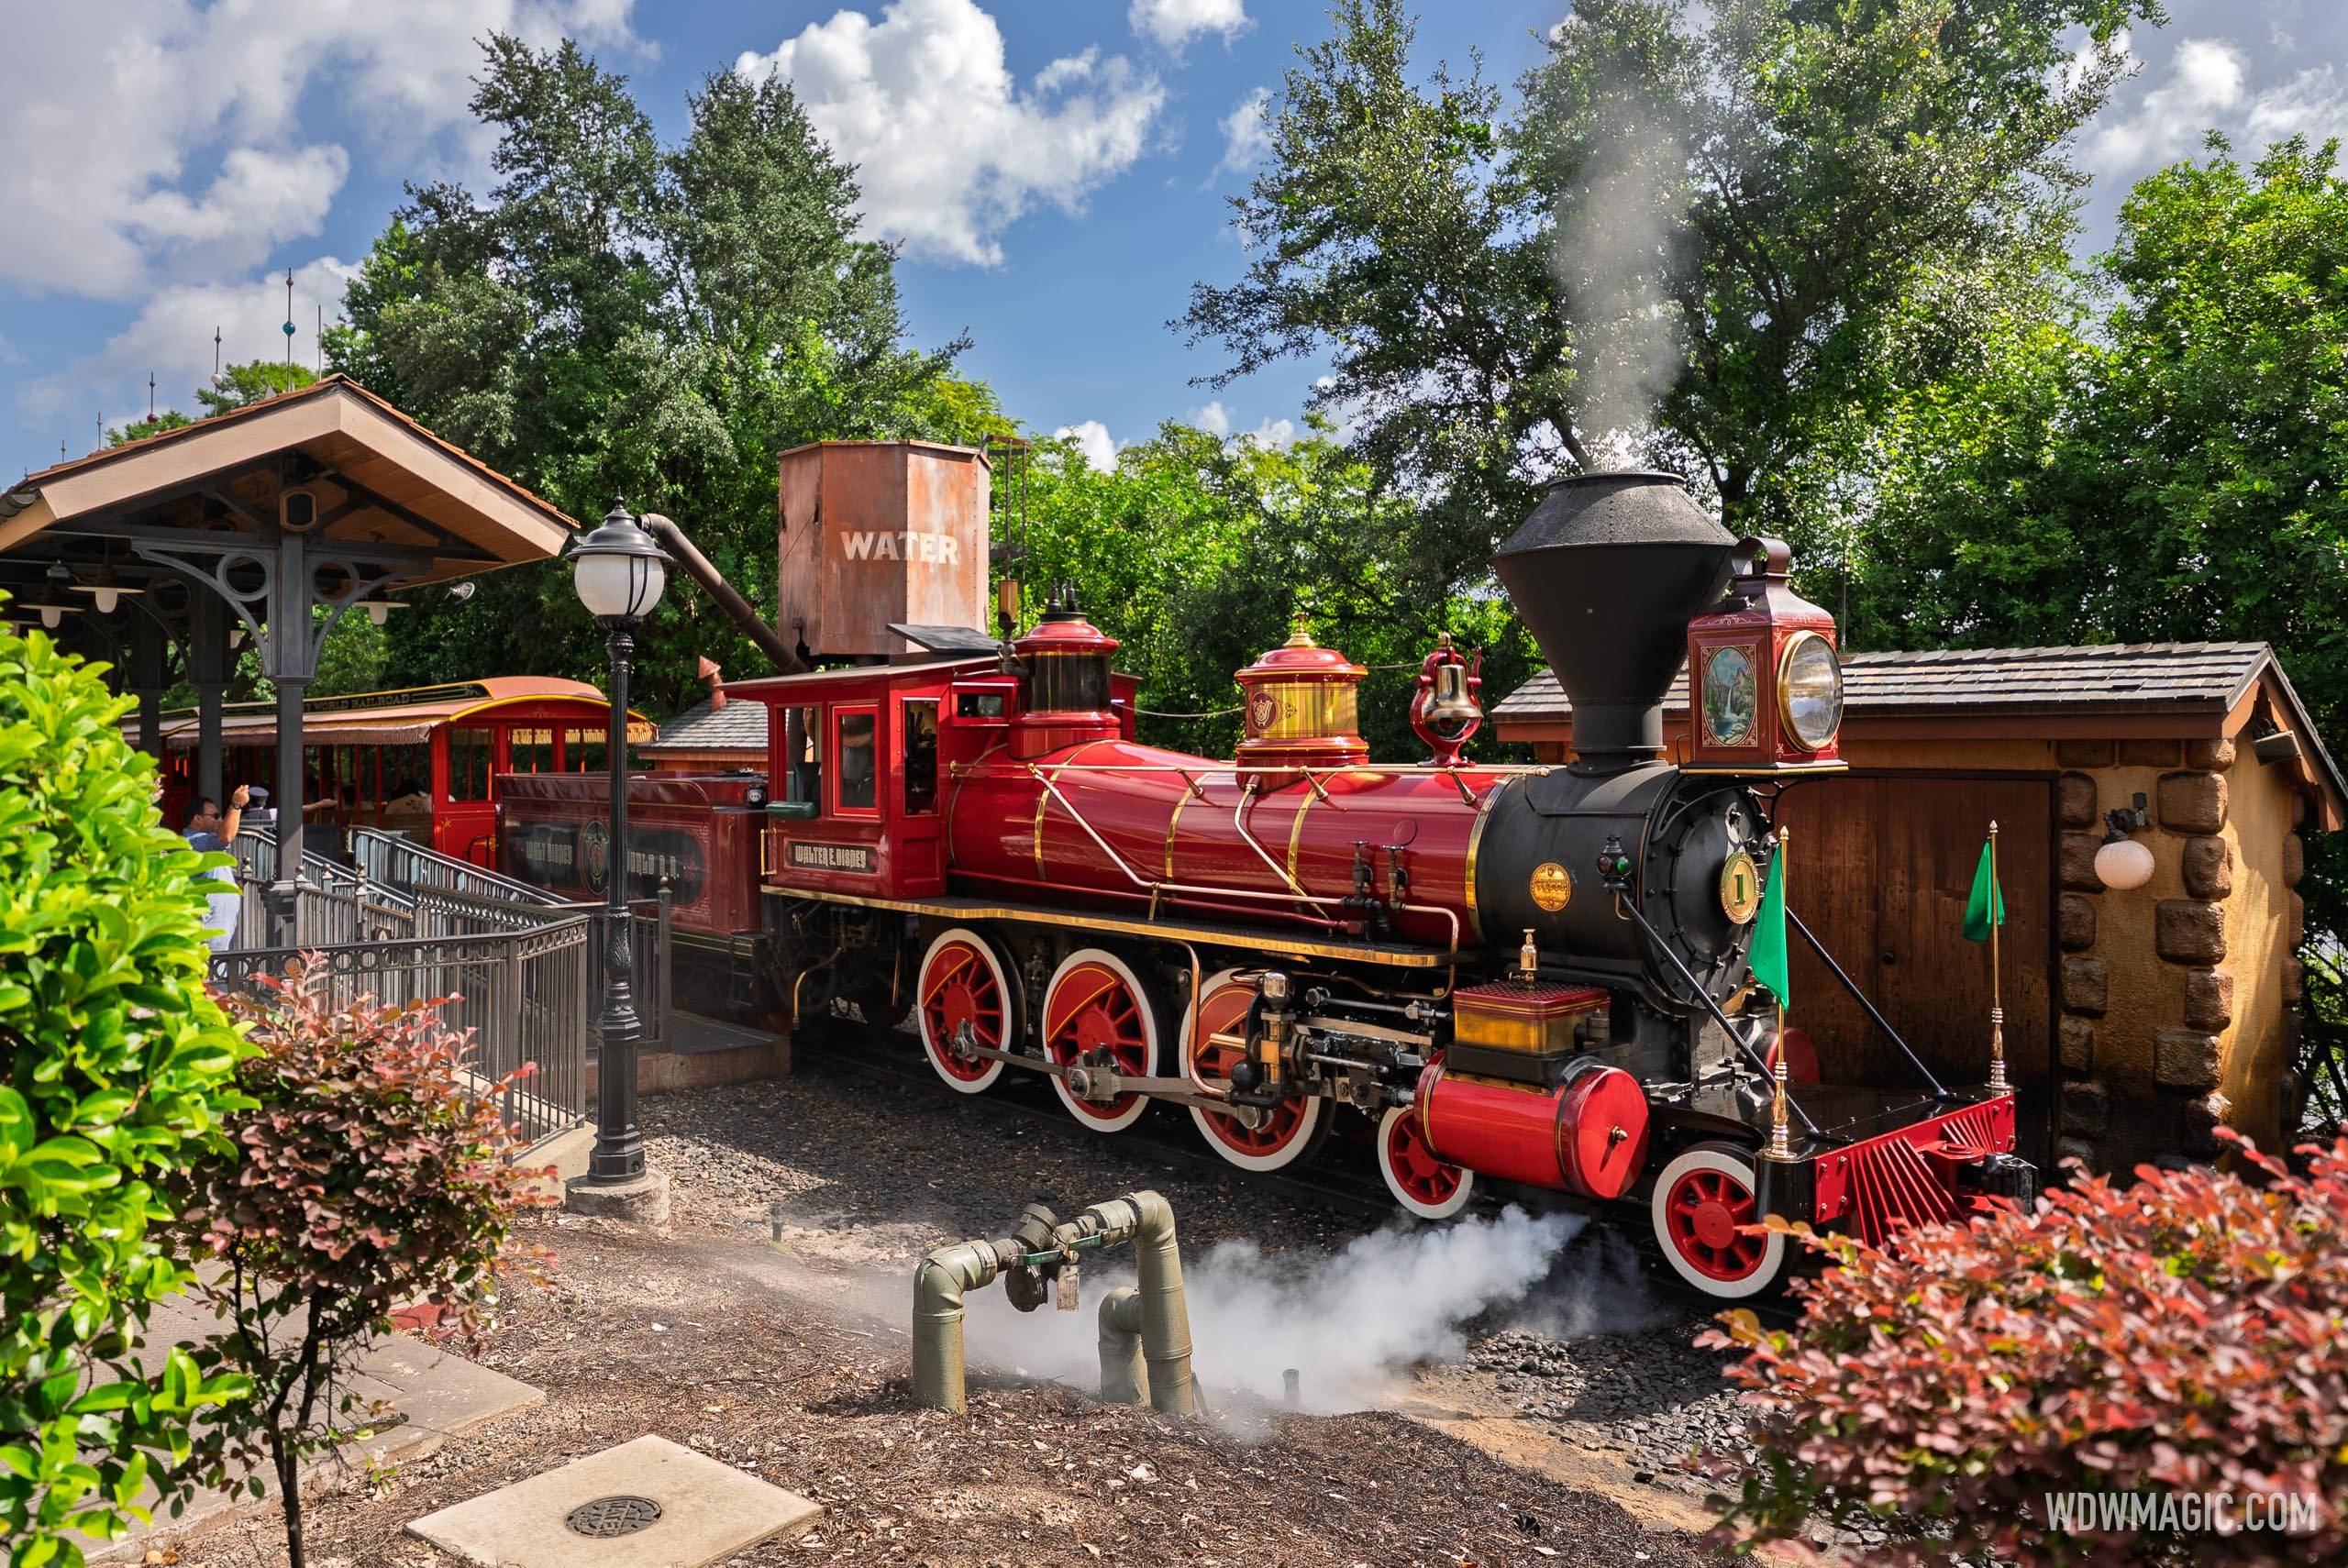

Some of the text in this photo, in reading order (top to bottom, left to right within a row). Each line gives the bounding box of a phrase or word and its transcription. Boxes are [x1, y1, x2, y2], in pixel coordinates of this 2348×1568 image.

[839, 531, 958, 565] WATER
[313, 700, 348, 711] WORLD
[351, 693, 410, 709] RAILROAD
[526, 841, 546, 862] WALT
[547, 843, 572, 865] DISNEY
[795, 845, 829, 867] WALTER
[836, 848, 867, 868] DISNEY
[1733, 873, 1746, 906] 1
